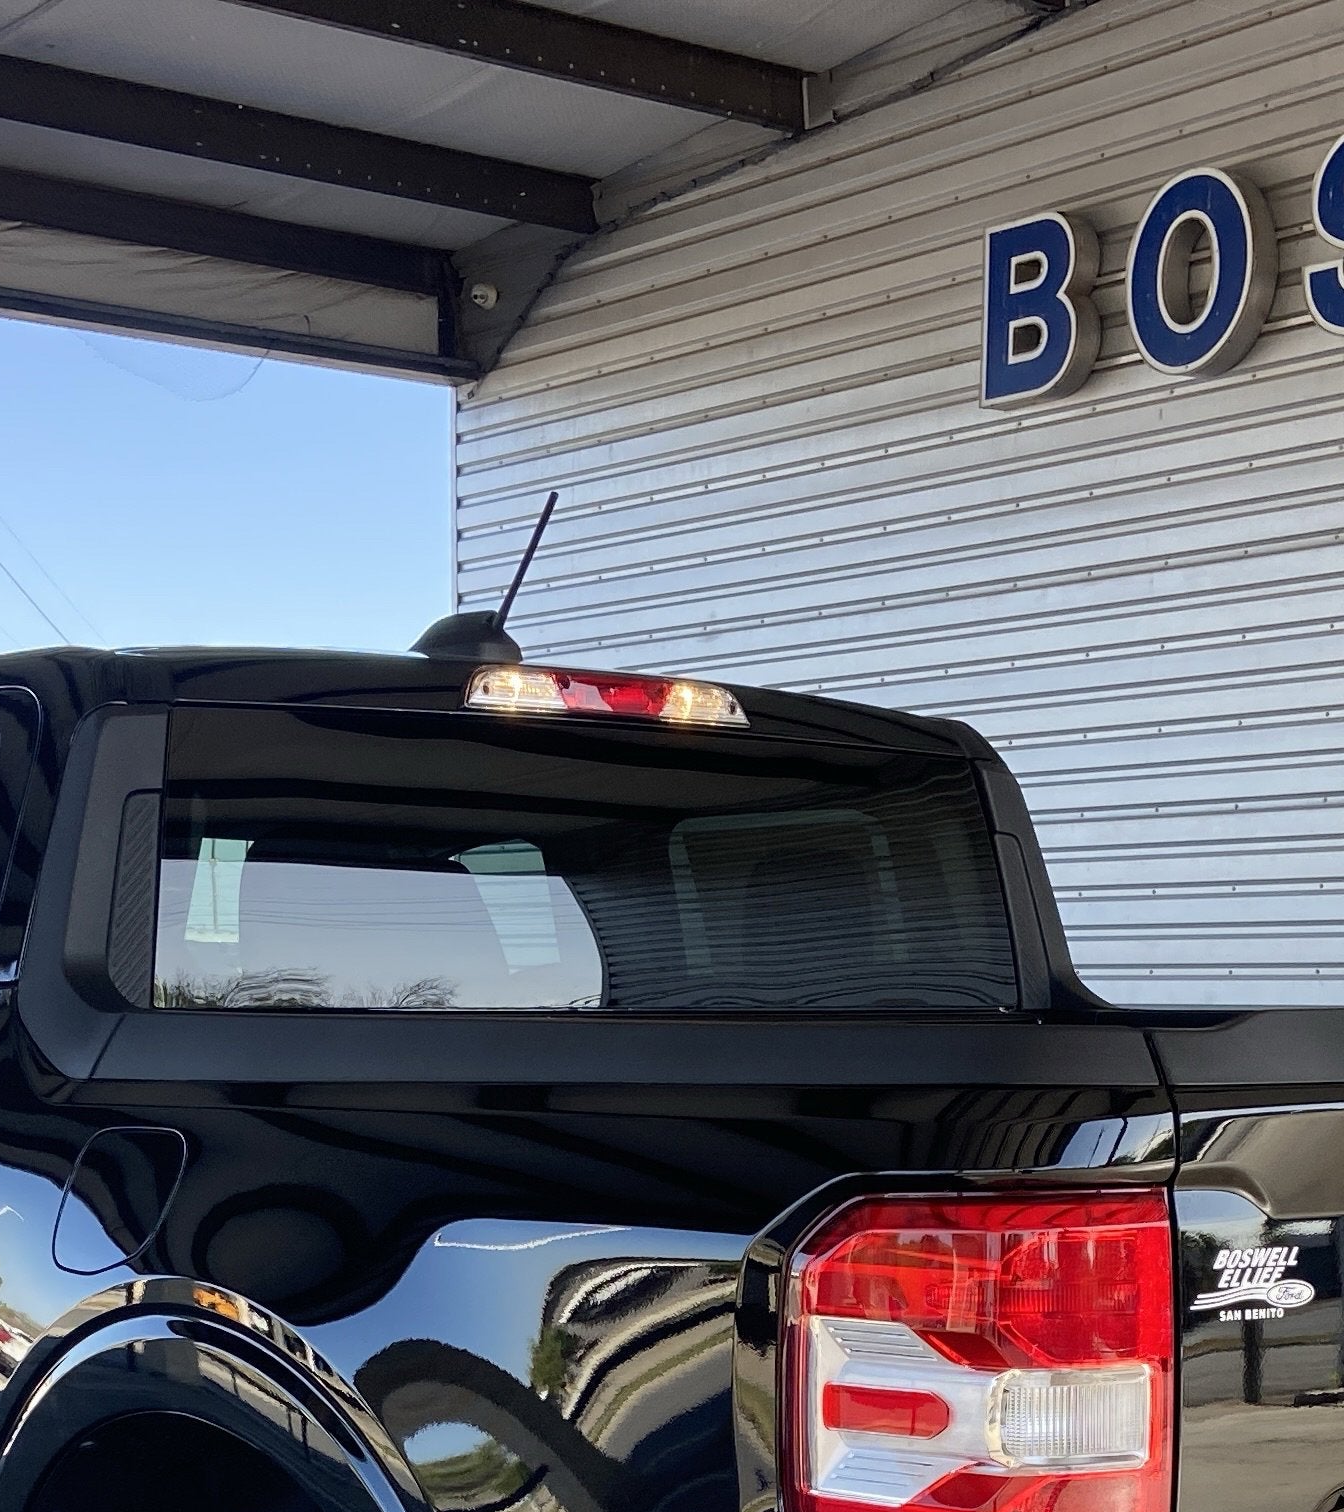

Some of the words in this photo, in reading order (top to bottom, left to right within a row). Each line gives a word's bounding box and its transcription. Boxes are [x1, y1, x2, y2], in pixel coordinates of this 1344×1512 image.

[1213, 1246, 1299, 1270] BOSWELL
[1275, 1286, 1305, 1301] Ford
[1219, 1309, 1242, 1322] SAN
[1244, 1307, 1285, 1321] BENITO
